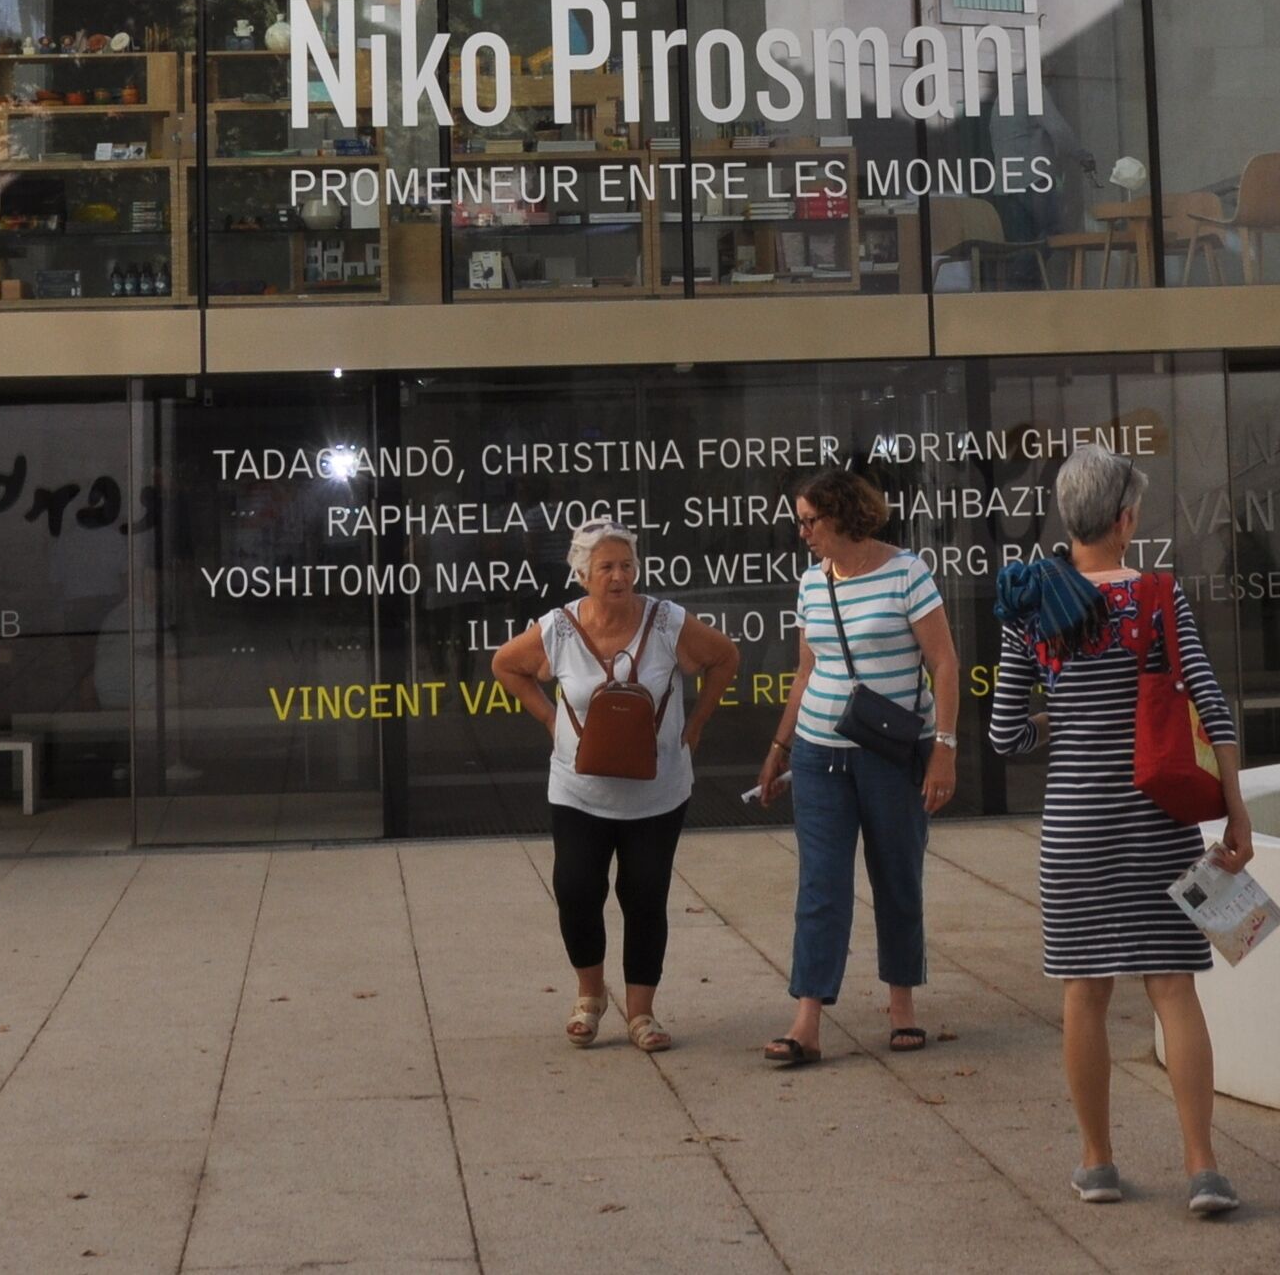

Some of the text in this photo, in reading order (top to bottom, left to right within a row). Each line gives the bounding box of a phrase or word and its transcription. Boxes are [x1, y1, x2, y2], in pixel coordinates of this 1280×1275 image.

[291, 156, 1055, 206] PROMENEUR ENTRE LES MONDES
[481, 439, 685, 476] CHRISTINA
[698, 435, 852, 471] FORRER,
[867, 430, 1007, 464] ADRIAN
[1021, 425, 1154, 459] GHENIE
[328, 486, 1045, 537] RAPHAELA VOGEL, SHIRA HAHBAZI
[1180, 489, 1275, 535] VAN
[200, 563, 421, 598] YOSHITOMO
[436, 559, 549, 598] NARA,
[269, 681, 446, 721] VINCENT
